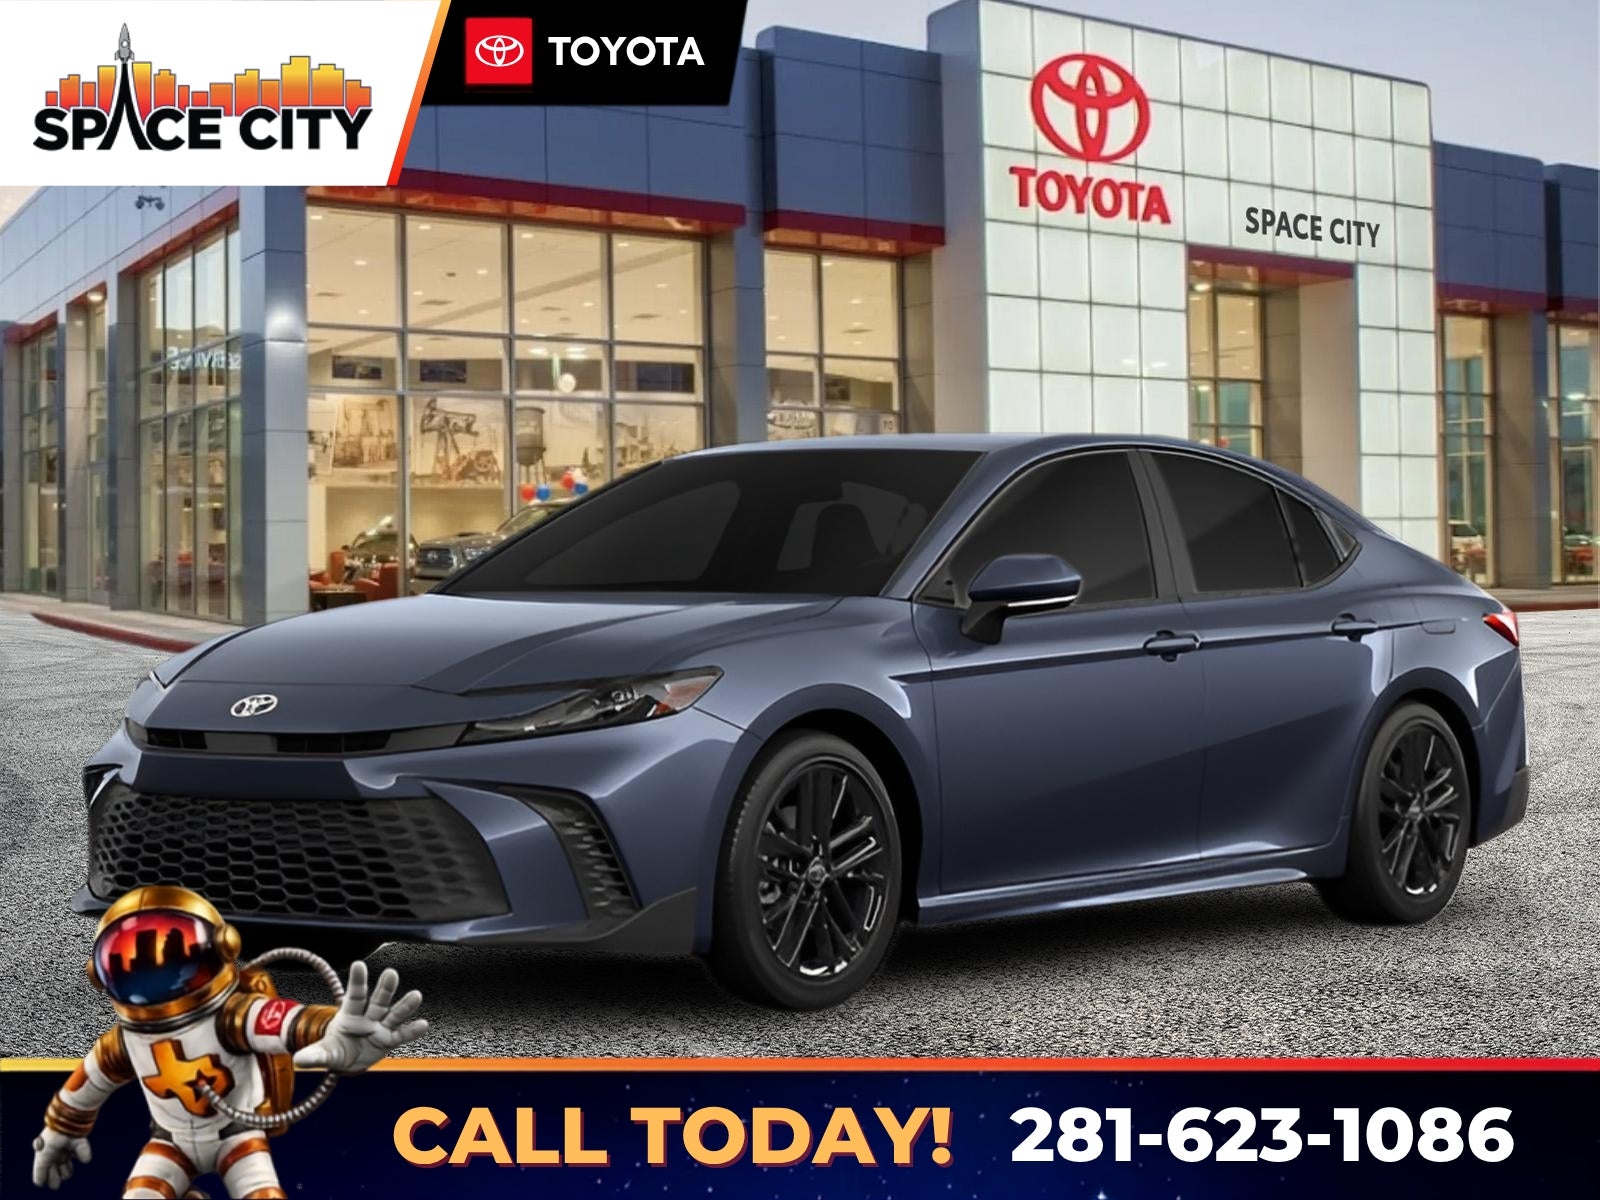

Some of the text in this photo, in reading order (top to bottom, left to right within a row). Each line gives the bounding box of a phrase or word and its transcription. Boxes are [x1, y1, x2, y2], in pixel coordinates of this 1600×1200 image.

[1009, 166, 1172, 225] TOYOTA
[1245, 206, 1381, 248] SPACE CITY
